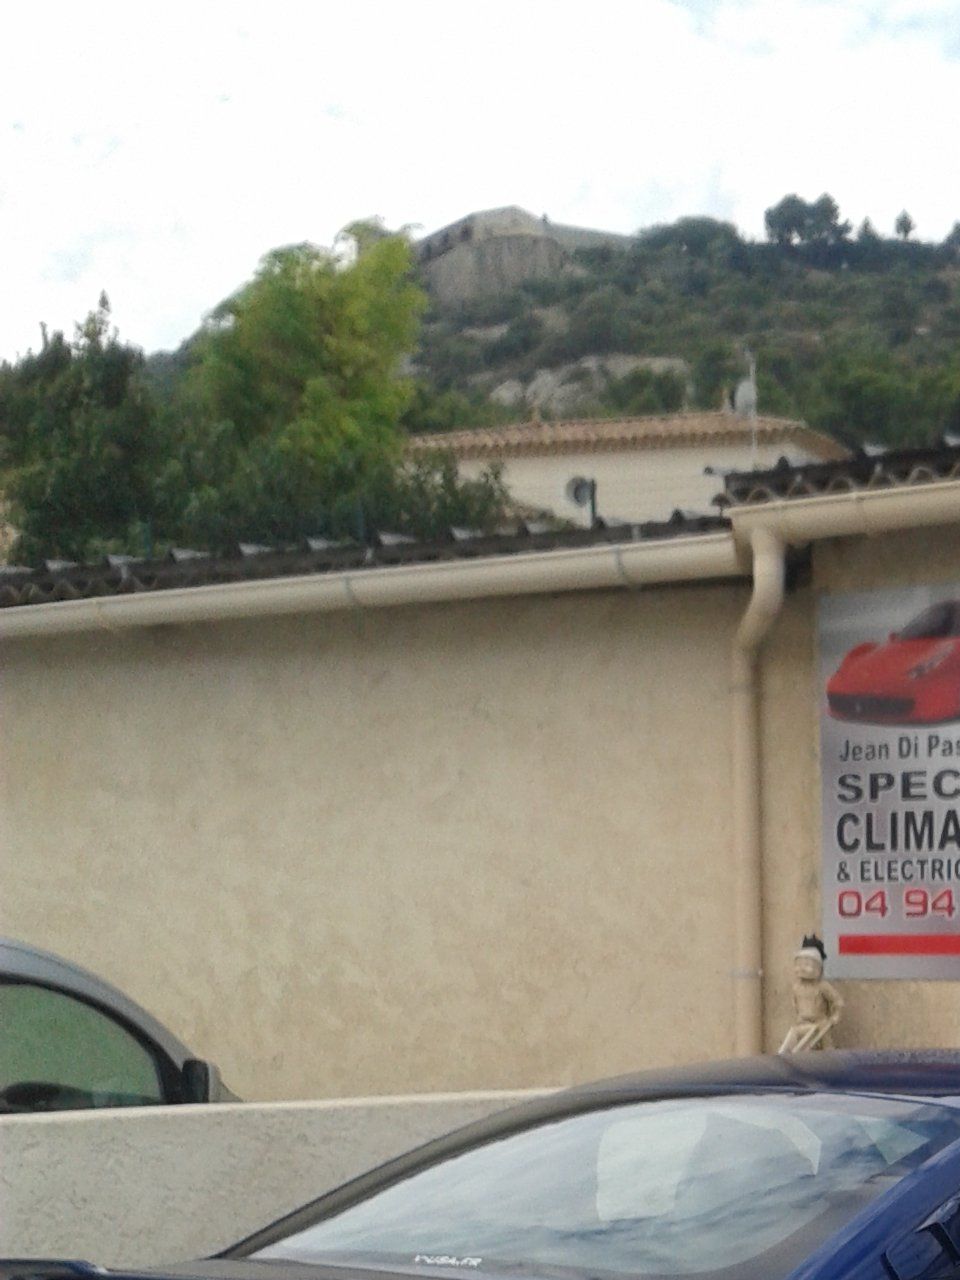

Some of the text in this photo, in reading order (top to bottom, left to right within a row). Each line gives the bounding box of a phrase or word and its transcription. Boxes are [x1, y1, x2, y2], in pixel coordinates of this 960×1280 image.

[839, 740, 889, 762] Jean
[898, 736, 919, 759] Di
[837, 861, 850, 882] &
[838, 890, 888, 918] 04
[904, 889, 955, 917] 94
